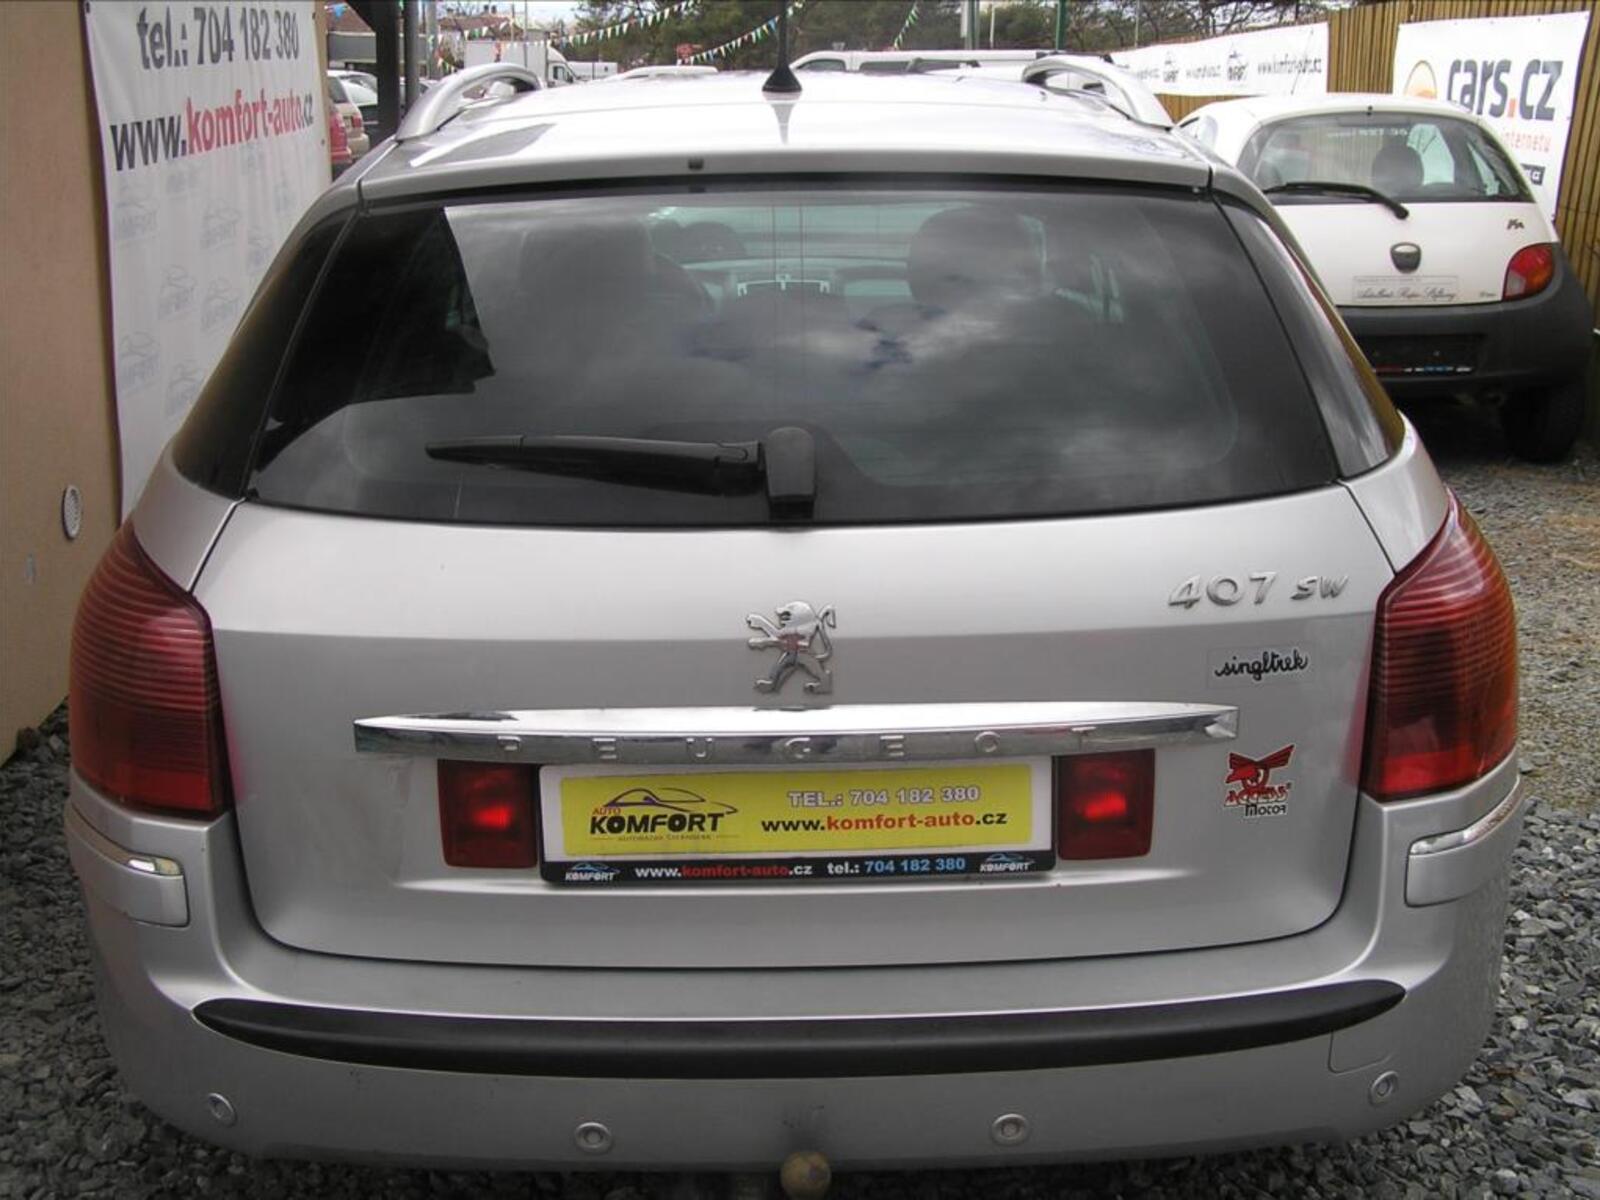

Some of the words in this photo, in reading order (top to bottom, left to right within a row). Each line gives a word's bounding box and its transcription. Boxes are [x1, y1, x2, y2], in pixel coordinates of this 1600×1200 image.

[136, 6, 188, 70] tel.:
[193, 6, 235, 65] 704
[239, 7, 271, 61] 182
[274, 9, 299, 60] 380
[1446, 58, 1564, 121] cars.cz
[109, 88, 314, 172] www.komfort-auto.cz
[1168, 571, 1278, 610] 407
[1214, 649, 1309, 682] singltrek
[497, 726, 1100, 760] PEUGEOT
[788, 791, 843, 807] TEL.:
[850, 789, 888, 805] 704
[897, 788, 934, 804] 182
[942, 786, 980, 802] 380
[591, 807, 622, 816] AUTO
[761, 811, 1008, 832] www.komfort-auto.cz
[589, 812, 725, 835] KOMFORT
[564, 871, 616, 881] KOMFORT
[635, 864, 813, 879] www.komfort-auto.cz
[827, 862, 860, 875] tel.:
[864, 860, 895, 873] 704
[901, 859, 931, 872] 182
[936, 858, 966, 871] 380
[979, 861, 1031, 872] KOMFORT
